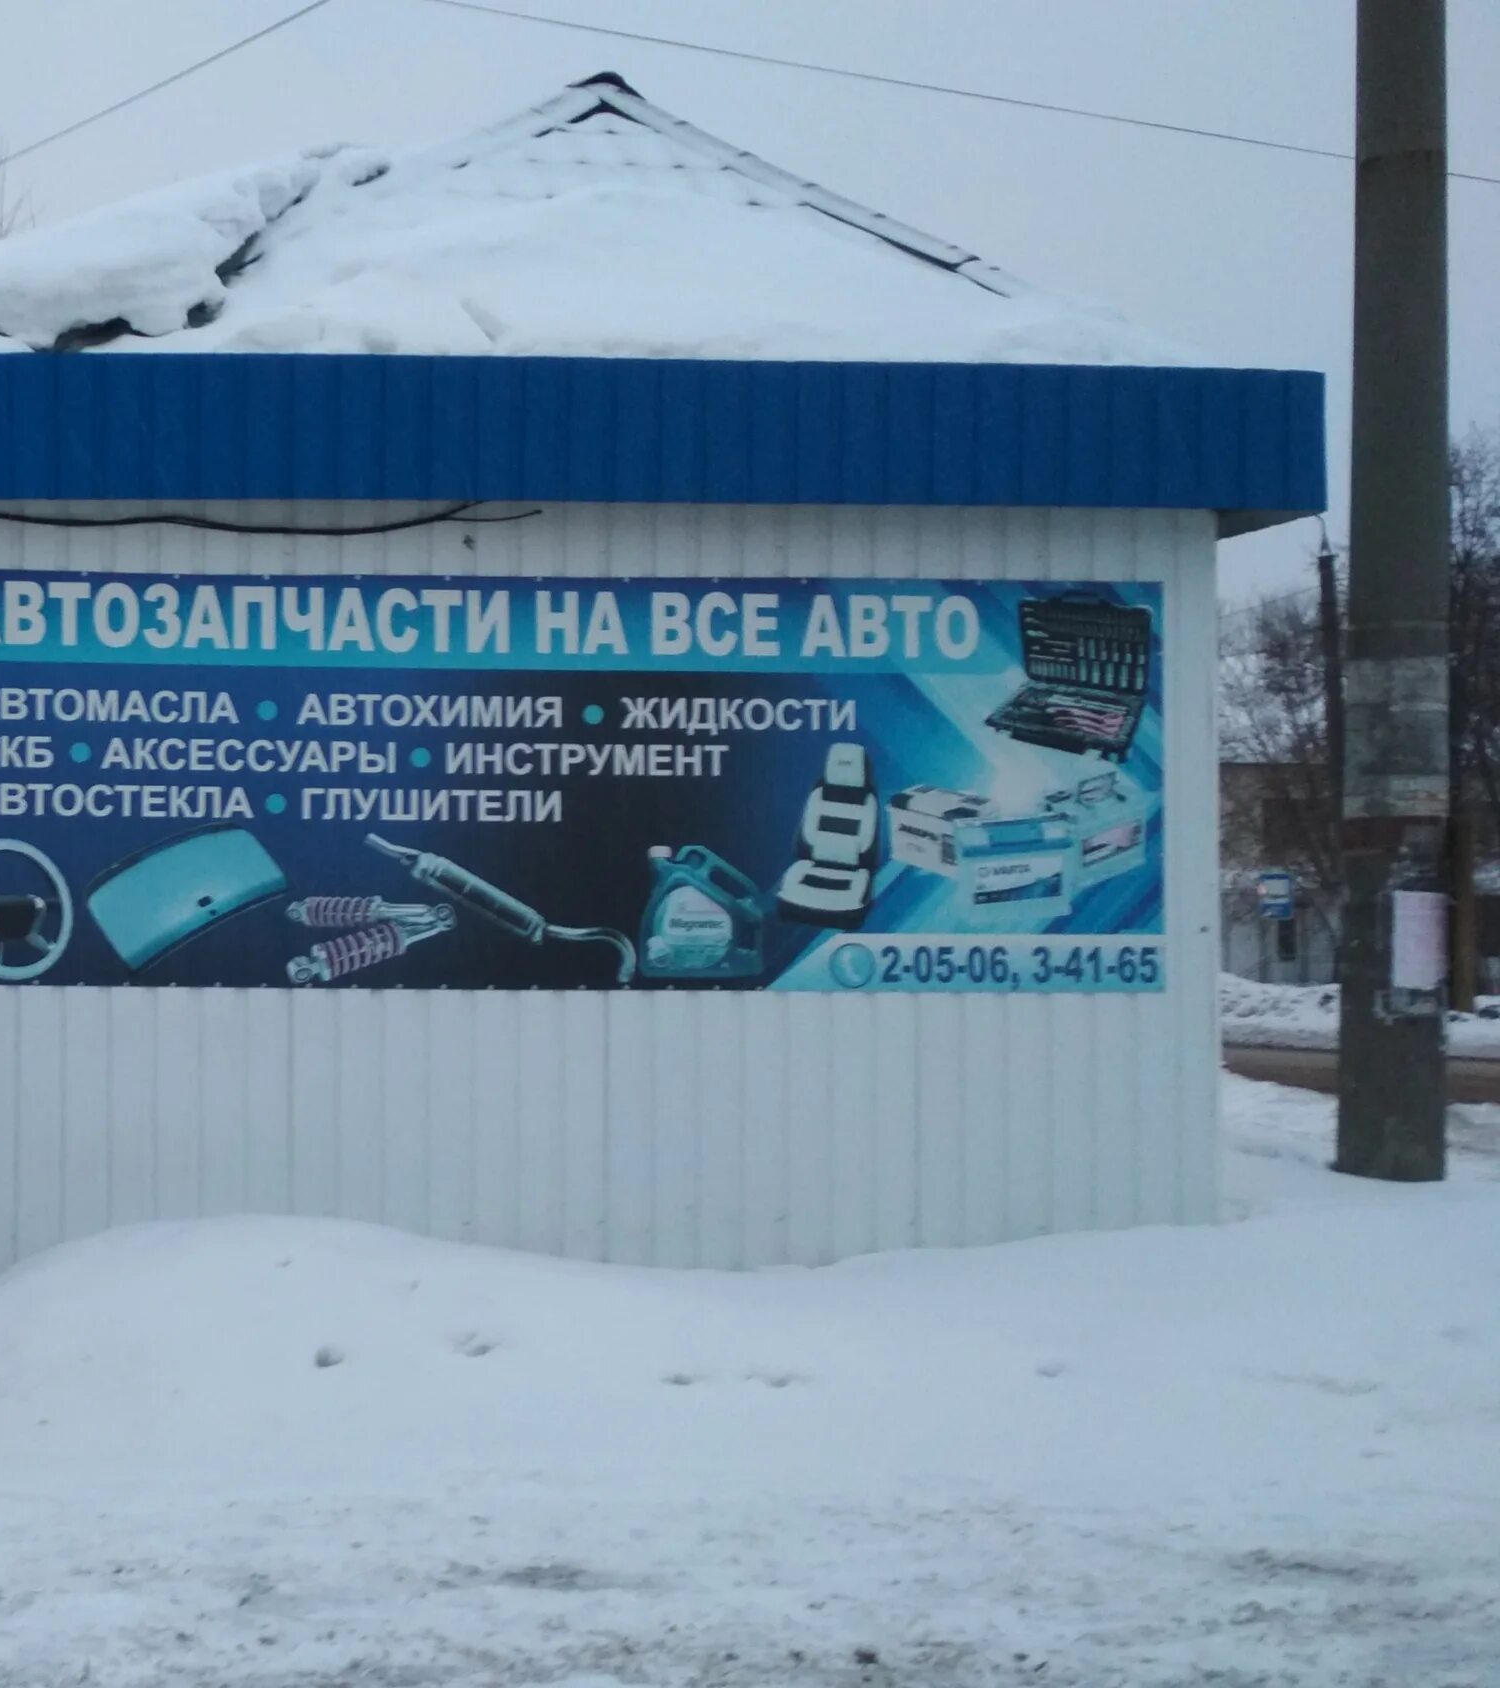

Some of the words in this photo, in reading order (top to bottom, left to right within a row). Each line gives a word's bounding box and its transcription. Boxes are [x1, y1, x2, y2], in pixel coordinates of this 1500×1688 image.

[534, 590, 630, 656] НА
[650, 591, 781, 658] ВСЕ
[801, 593, 981, 661] АВТО
[296, 693, 564, 729] АВТОХИМИЯ
[620, 696, 857, 737] ЖИДКОСТИ
[100, 737, 397, 775] АКСЕССУАРЫ
[445, 742, 730, 778] ИНСТРУМЕНТ
[301, 787, 563, 823] ГЛУШИТЕЛИ
[880, 945, 1020, 990] 2-05-06,
[1030, 946, 1159, 984] 3-41-65
